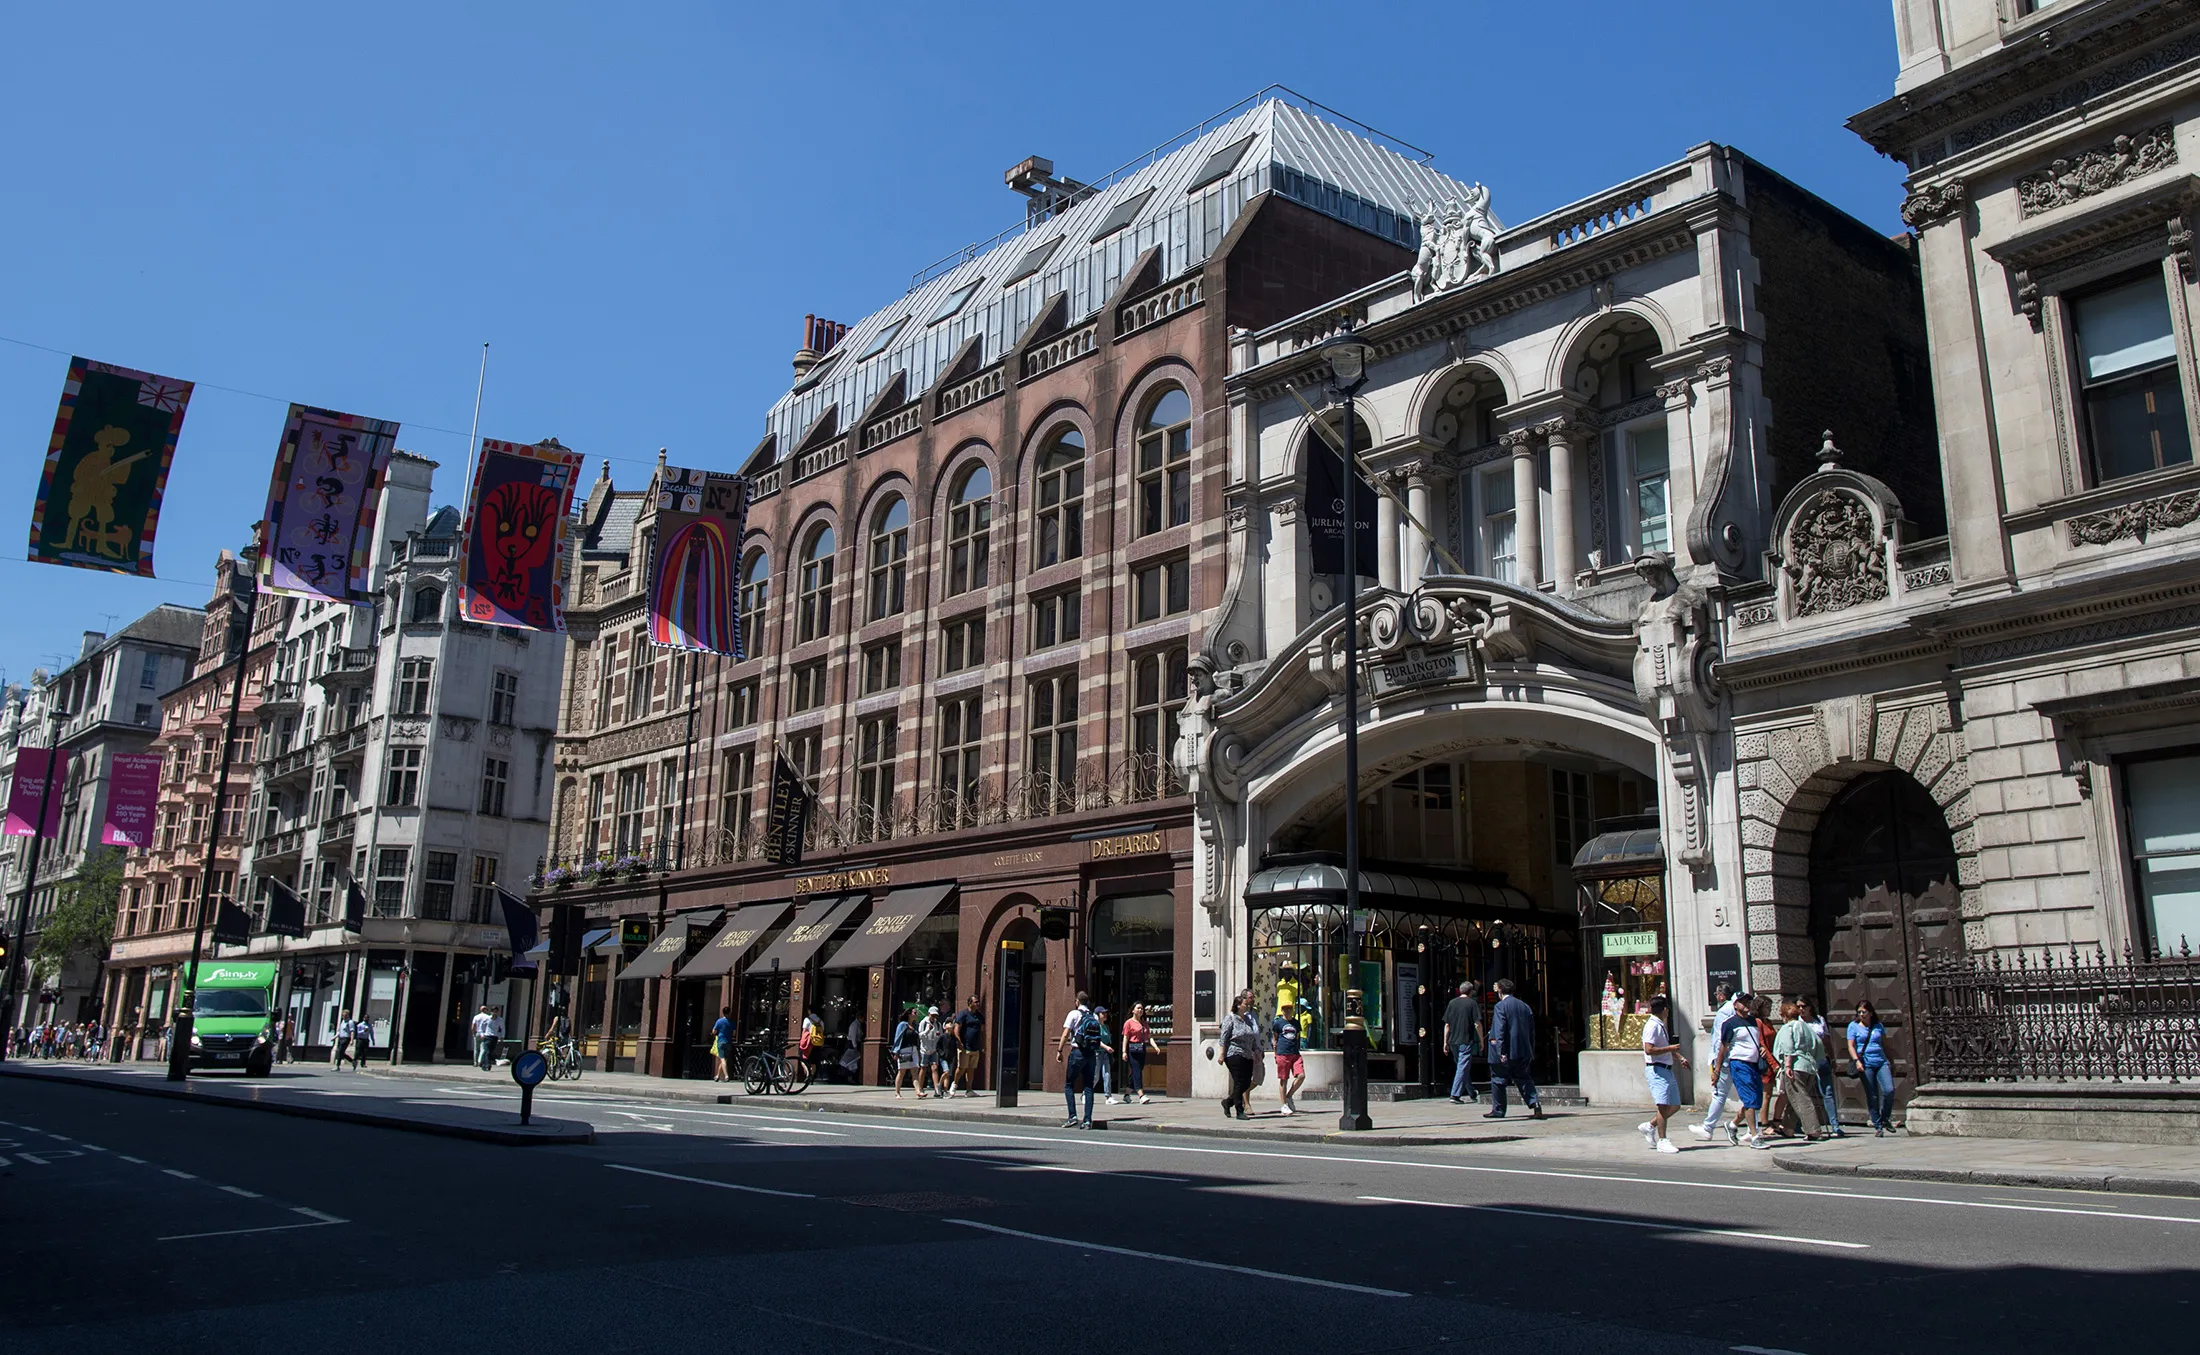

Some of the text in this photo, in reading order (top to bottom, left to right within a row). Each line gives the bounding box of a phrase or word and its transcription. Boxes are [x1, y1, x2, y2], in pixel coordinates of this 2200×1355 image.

[332, 555, 346, 570] 3
[1383, 655, 1457, 682] BURLINGTON
[1407, 671, 1437, 684] ARCADE
[132, 757, 160, 765] Academy
[766, 775, 792, 861] BENTLEY
[785, 797, 803, 856] SKINNER
[873, 914, 917, 926] BENTLEY
[1714, 905, 1730, 927] 51
[1201, 942, 1212, 958] 51
